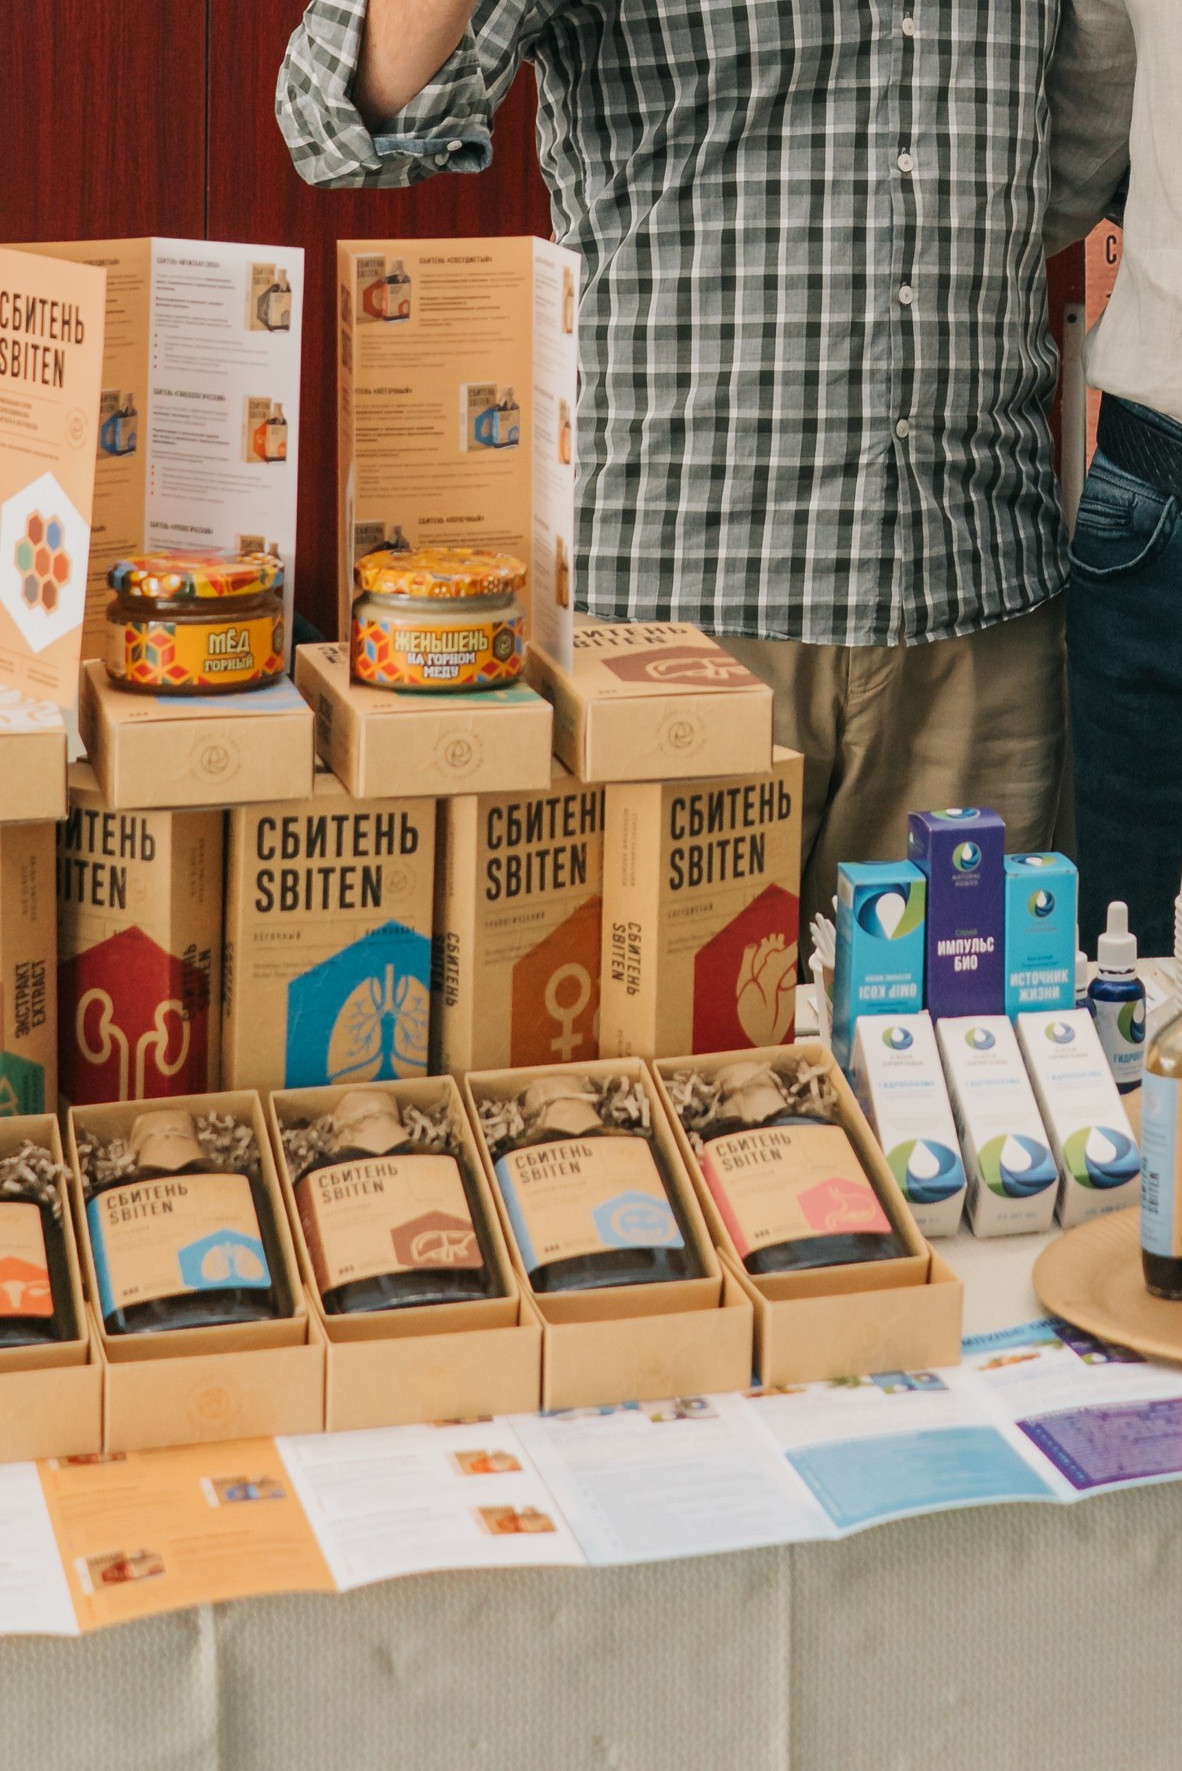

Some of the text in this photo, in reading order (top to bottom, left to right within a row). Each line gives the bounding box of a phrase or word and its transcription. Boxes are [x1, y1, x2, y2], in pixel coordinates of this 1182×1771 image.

[394, 629, 488, 654] ЖЕНЬШЕНЬ
[574, 625, 689, 640] ИТЕНЬ
[574, 636, 667, 650] BITEN
[204, 654, 254, 673] ГОРНЫЙ
[407, 652, 476, 667] НА ГОРНОМ
[422, 665, 460, 679] МЕДУ
[670, 779, 792, 841] СБИТЕНЬ
[57, 808, 156, 862] ИТЕНЬ
[256, 812, 419, 861] СБИТЕНЬ
[486, 842, 588, 901] SBITEN
[669, 832, 766, 891] SBITEN
[57, 856, 128, 910] ITEN
[255, 865, 383, 913] SBITEN
[611, 923, 626, 982] SBITEN
[627, 922, 642, 996] СБИТЕНЬ
[937, 937, 994, 956] ИМПУЛЬС
[446, 932, 460, 1007] СБИТЕНЬ
[954, 955, 978, 972] БИО
[1010, 969, 1069, 987] ИСТОЧНИК
[1018, 986, 1060, 1002] ЖИЗНИ
[515, 1145, 593, 1170] СБИТЕНЬ
[715, 1132, 792, 1158] СБИТЕНЬ
[721, 1148, 783, 1172] SBITEN
[318, 1163, 398, 1189] СБИТЕНЬ
[519, 1161, 581, 1185] SBITEN
[106, 1183, 188, 1210] СБИТЕНЬ
[322, 1180, 385, 1204] SBITEN
[109, 1199, 174, 1225] SBITEN
